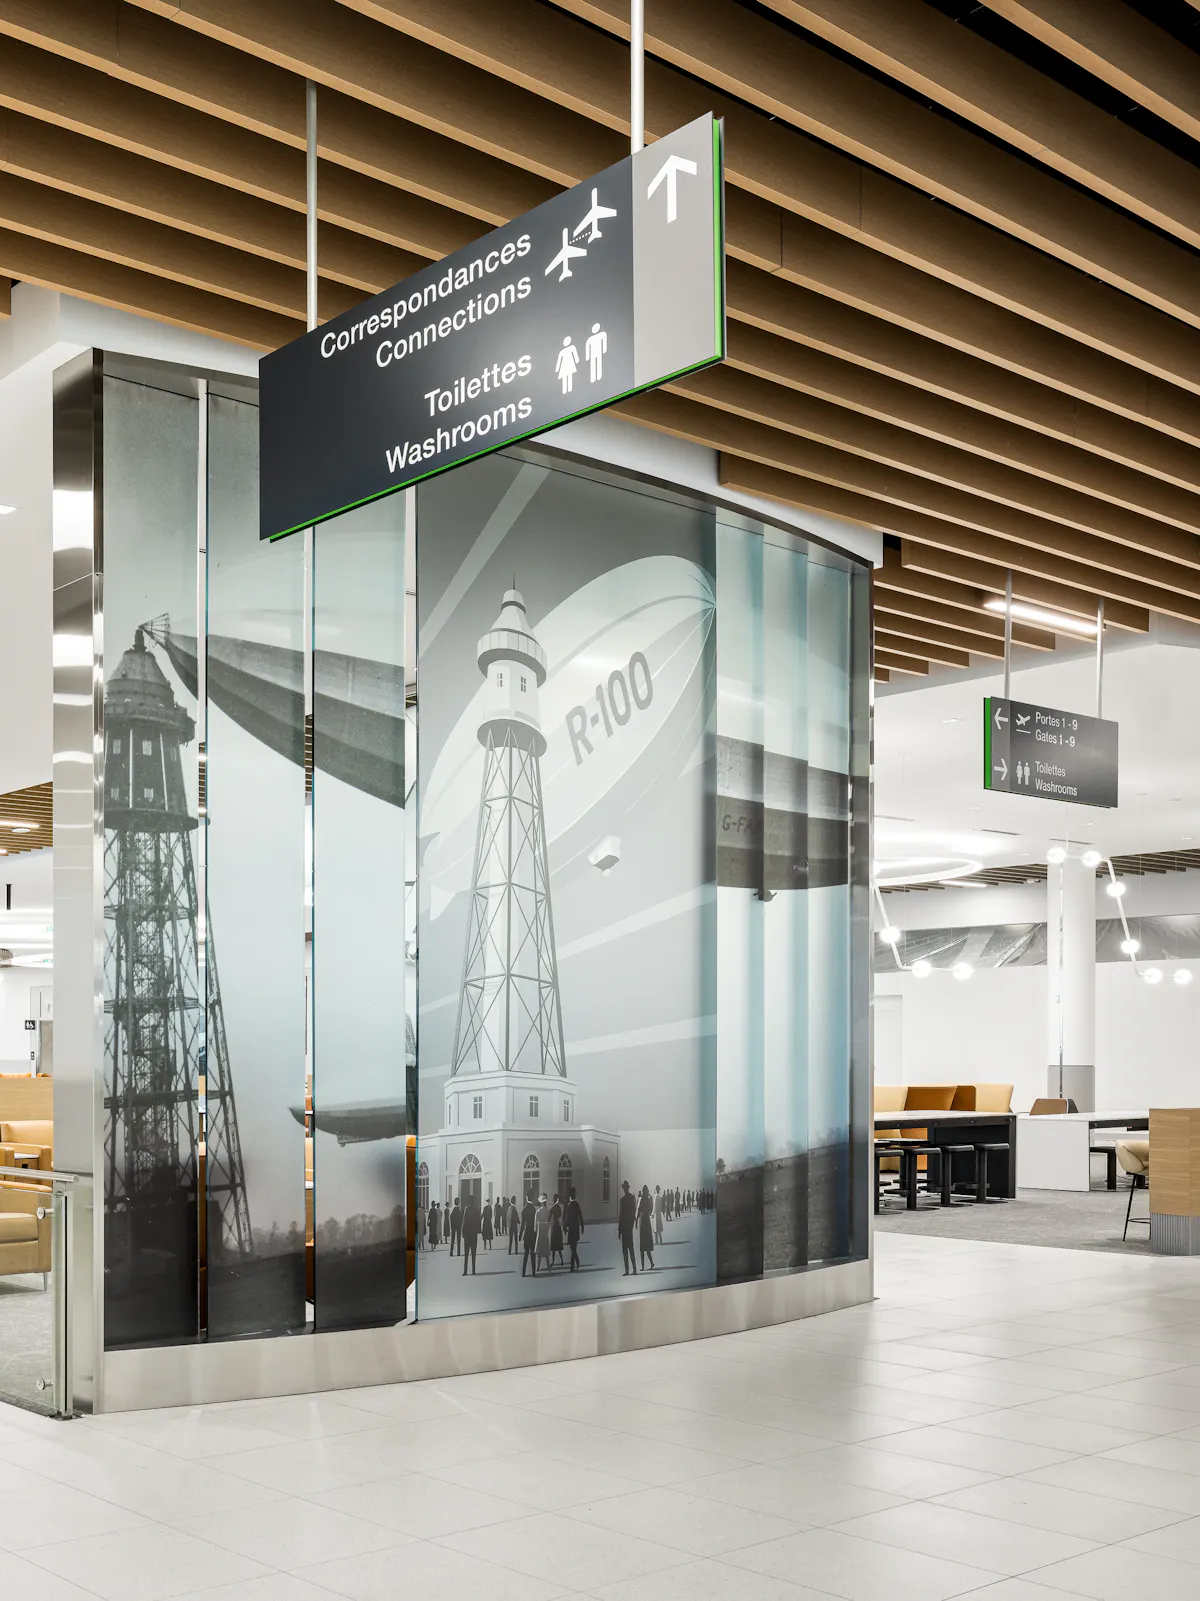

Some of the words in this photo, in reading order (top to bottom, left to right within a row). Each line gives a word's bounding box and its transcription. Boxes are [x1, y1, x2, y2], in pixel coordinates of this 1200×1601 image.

[320, 234, 532, 359] Correspondances
[376, 276, 532, 368] Connections
[424, 354, 532, 417] Toilettes
[385, 396, 532, 474] Washrooms
[565, 651, 654, 766] R-100
[1035, 711, 1060, 727] Portes
[1061, 717, 1066, 728] 1
[1072, 719, 1078, 730] 9
[1035, 729, 1057, 744] Gates
[1059, 733, 1063, 745] 1
[1069, 735, 1075, 747] 9
[1035, 760, 1066, 777] Toilettes
[1035, 778, 1078, 796] Washrooms
